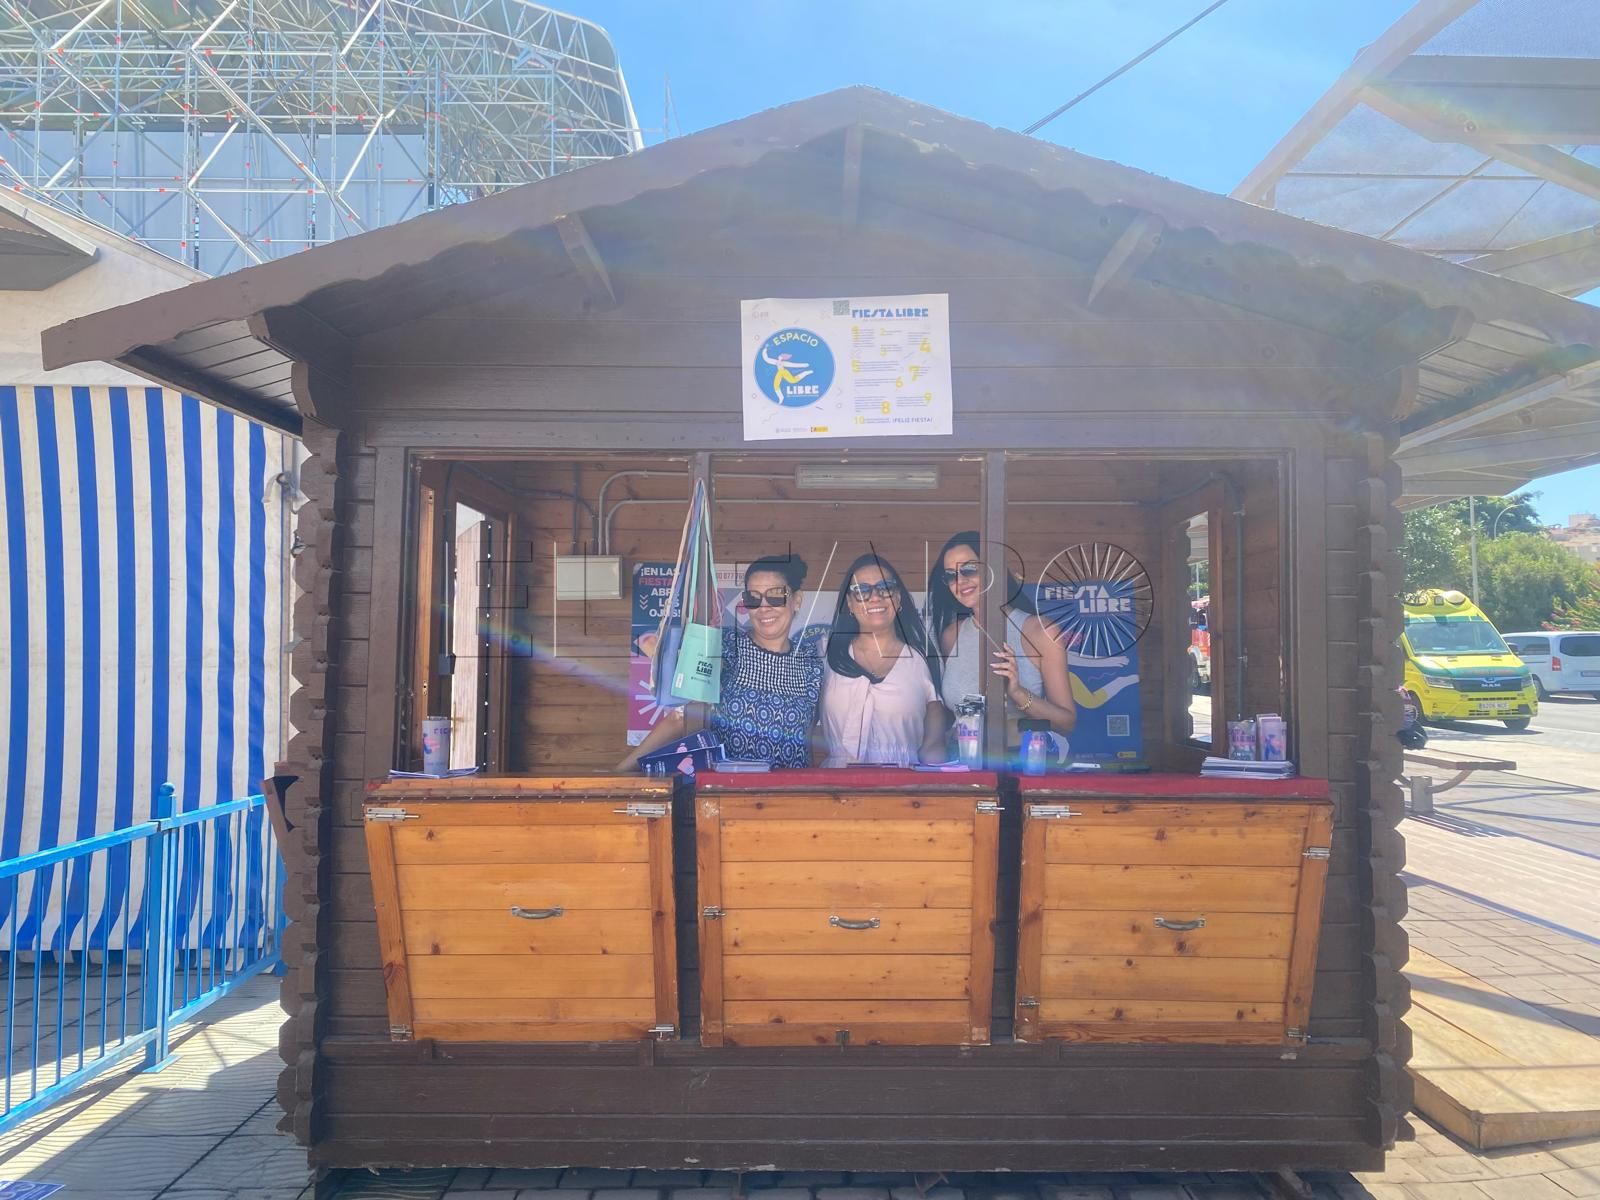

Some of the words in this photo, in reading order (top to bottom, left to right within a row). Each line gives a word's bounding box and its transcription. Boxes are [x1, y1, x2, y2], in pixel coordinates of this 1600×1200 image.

[852, 308, 893, 319] FIESTA
[895, 307, 929, 318] LIBRE
[772, 332, 819, 348] ESPACIO
[786, 384, 820, 395] LIBRE
[881, 401, 891, 415] 8
[1044, 585, 1110, 601] FIESTA
[1079, 598, 1132, 614] LIBRE
